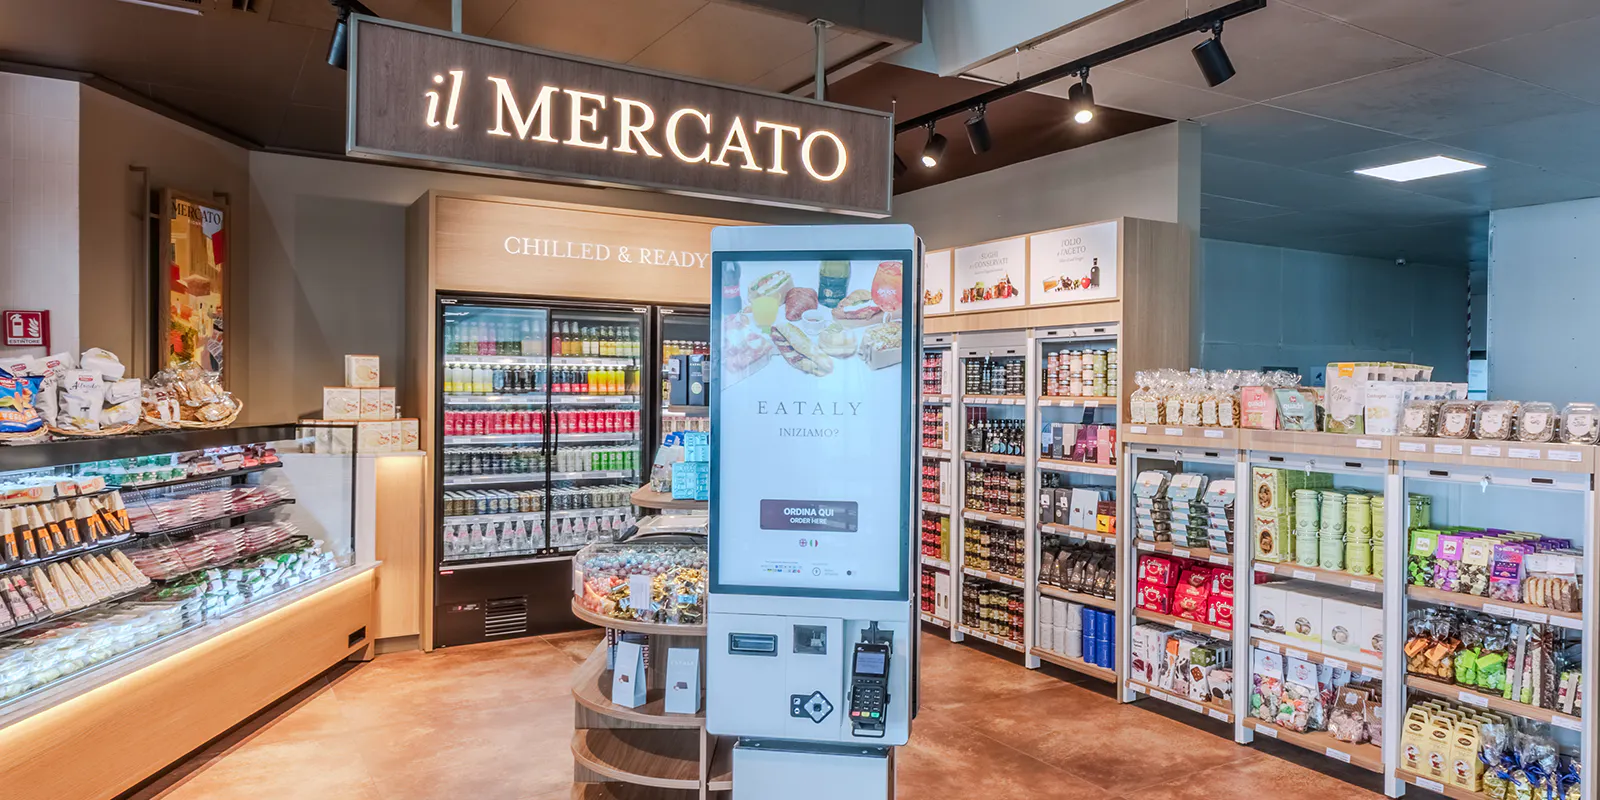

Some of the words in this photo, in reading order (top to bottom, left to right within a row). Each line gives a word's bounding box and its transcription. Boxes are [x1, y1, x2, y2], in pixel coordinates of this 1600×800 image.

[424, 70, 464, 130] il
[486, 76, 848, 183] MERCATO
[171, 200, 221, 225] MERCATO
[503, 236, 611, 261] CHILLED
[617, 245, 634, 264] &
[639, 247, 709, 269] READY
[757, 400, 862, 416] EATALY
[779, 427, 840, 438] INIZIAMO?
[783, 507, 817, 516] ORDINA
[818, 508, 834, 517] QUI
